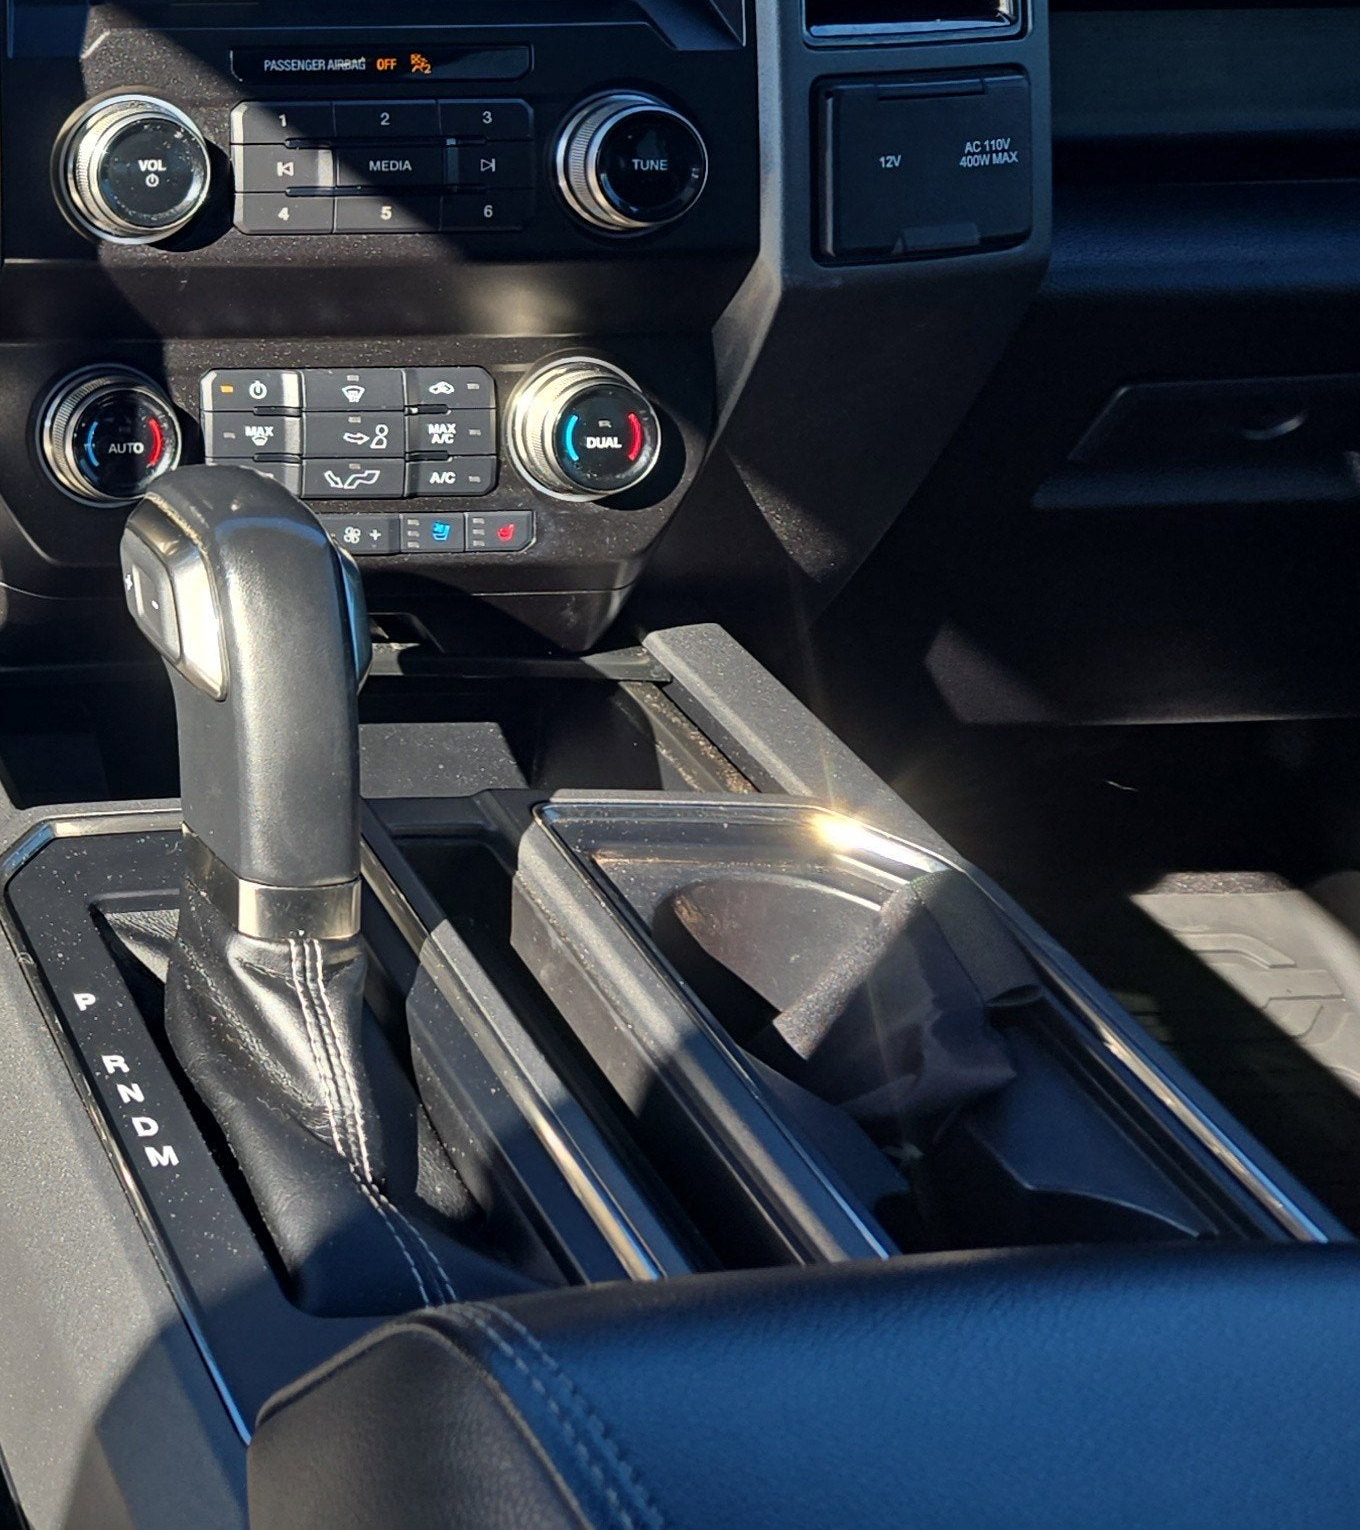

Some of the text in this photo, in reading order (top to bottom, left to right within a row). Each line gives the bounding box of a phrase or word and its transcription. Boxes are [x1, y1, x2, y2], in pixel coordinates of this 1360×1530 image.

[264, 58, 397, 71] PASSENGER AIRBAG OFF
[279, 113, 288, 128] 1
[380, 112, 390, 126] 2
[482, 111, 493, 124] 3
[964, 138, 1011, 154] AC 110V
[138, 159, 167, 172] VOL
[369, 160, 413, 171] MEDIA
[632, 159, 668, 171] TUNE
[879, 155, 902, 168] 12V
[959, 151, 1019, 168] 400W MAX
[278, 207, 290, 221] 4
[381, 206, 392, 220] 5
[483, 205, 494, 218] 6
[244, 425, 274, 438] MAX
[428, 423, 457, 435] MAX
[431, 434, 455, 445] A/C
[586, 436, 623, 449] DUAL
[108, 442, 145, 454] AUTO
[429, 471, 456, 485] A/C
[73, 992, 97, 1011] P
[101, 1054, 130, 1074] R
[116, 1083, 145, 1103] N
[131, 1116, 159, 1137] D
[143, 1144, 180, 1168] M
